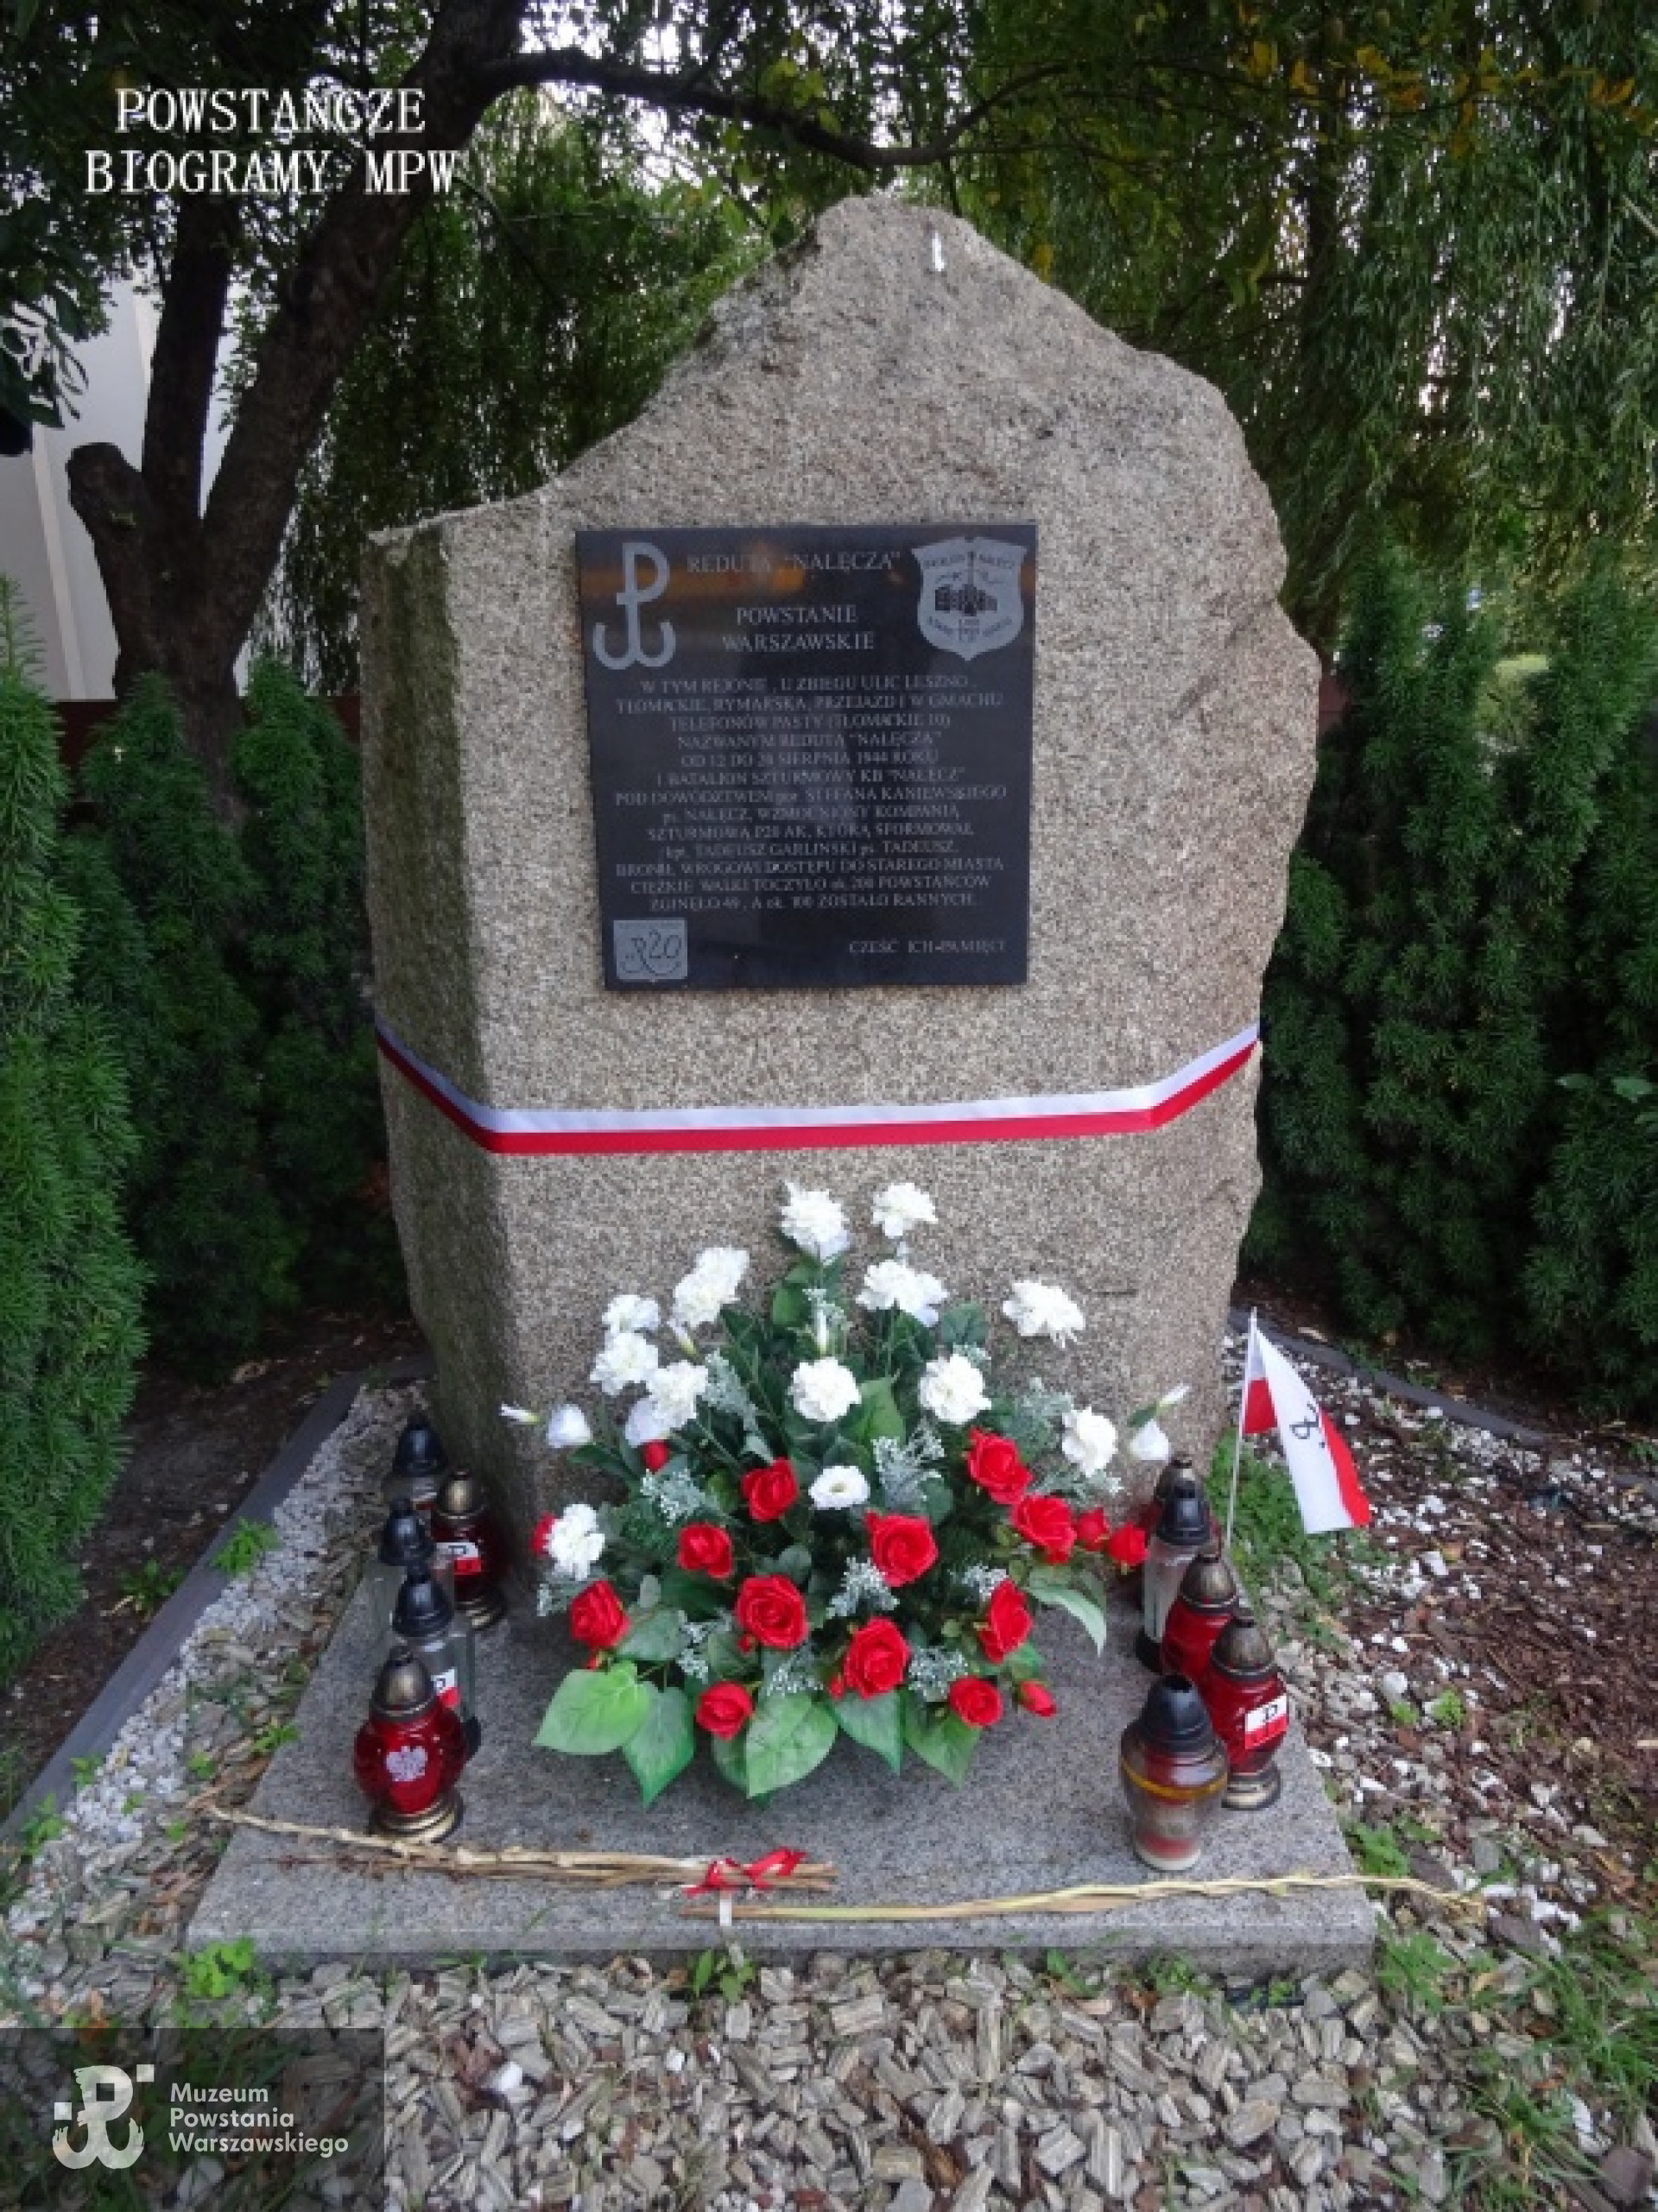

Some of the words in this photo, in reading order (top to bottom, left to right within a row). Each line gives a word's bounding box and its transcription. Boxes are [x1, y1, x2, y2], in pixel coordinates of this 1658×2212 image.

[737, 604, 857, 626] POWSTANIE
[722, 631, 875, 654] WARSZAWSKIE
[640, 679, 655, 693] W
[661, 679, 698, 693] TYM
[781, 677, 792, 692] U
[795, 676, 857, 692] ZBIEGU
[861, 674, 900, 691] ULIC
[814, 694, 895, 709] PRZEJAZD
[910, 694, 925, 708] W
[928, 692, 1003, 708] GMACHU
[772, 714, 823, 730] PASTY
[678, 734, 775, 750] NAZWANYM
[680, 754, 706, 768] OD
[731, 752, 754, 767] DO
[778, 750, 851, 766] SIERPNIA
[857, 750, 889, 765] 1944
[893, 748, 939, 764] ROKU
[667, 771, 748, 787] BATALION
[752, 768, 856, 786] SZTURMOWY
[860, 768, 883, 783] KB
[616, 792, 647, 806] POD
[805, 786, 877, 802] STEFANA
[881, 783, 1007, 800] KANIEWSKIEGO
[695, 842, 767, 856] TADEUSZ
[680, 861, 762, 875] WROGOWI
[839, 859, 864, 874] DO
[866, 856, 941, 872] STAREGO
[699, 877, 750, 893] WALKI
[751, 895, 763, 910] A
